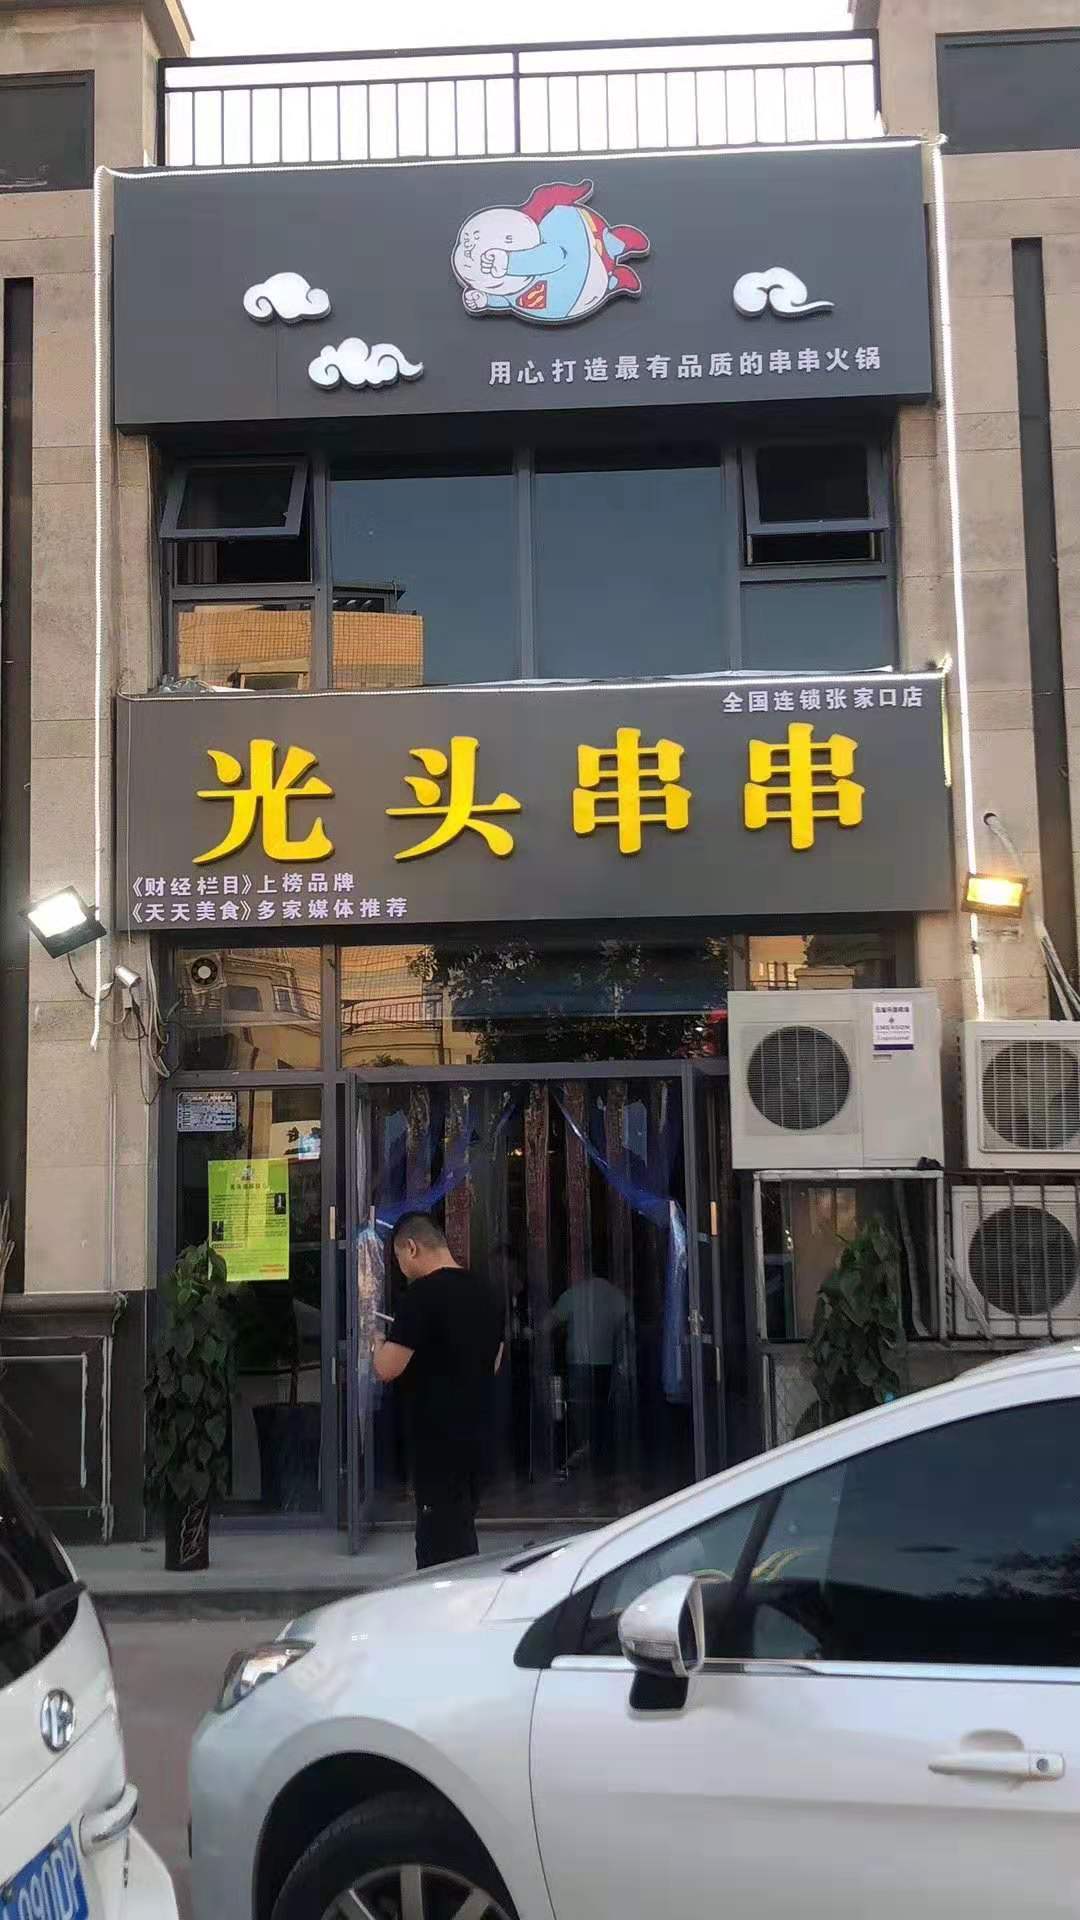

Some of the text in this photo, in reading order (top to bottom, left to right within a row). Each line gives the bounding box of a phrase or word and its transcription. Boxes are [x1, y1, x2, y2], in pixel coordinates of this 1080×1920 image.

[489, 346, 882, 385] 用心打造最有品质的串串火锅
[722, 686, 923, 713] 全国连锁张家口店
[193, 722, 866, 864] 光头串串
[131, 872, 355, 898] 《财经栏目》上榜品牌
[131, 897, 408, 924] 《天天美食》多家媒体推荐
